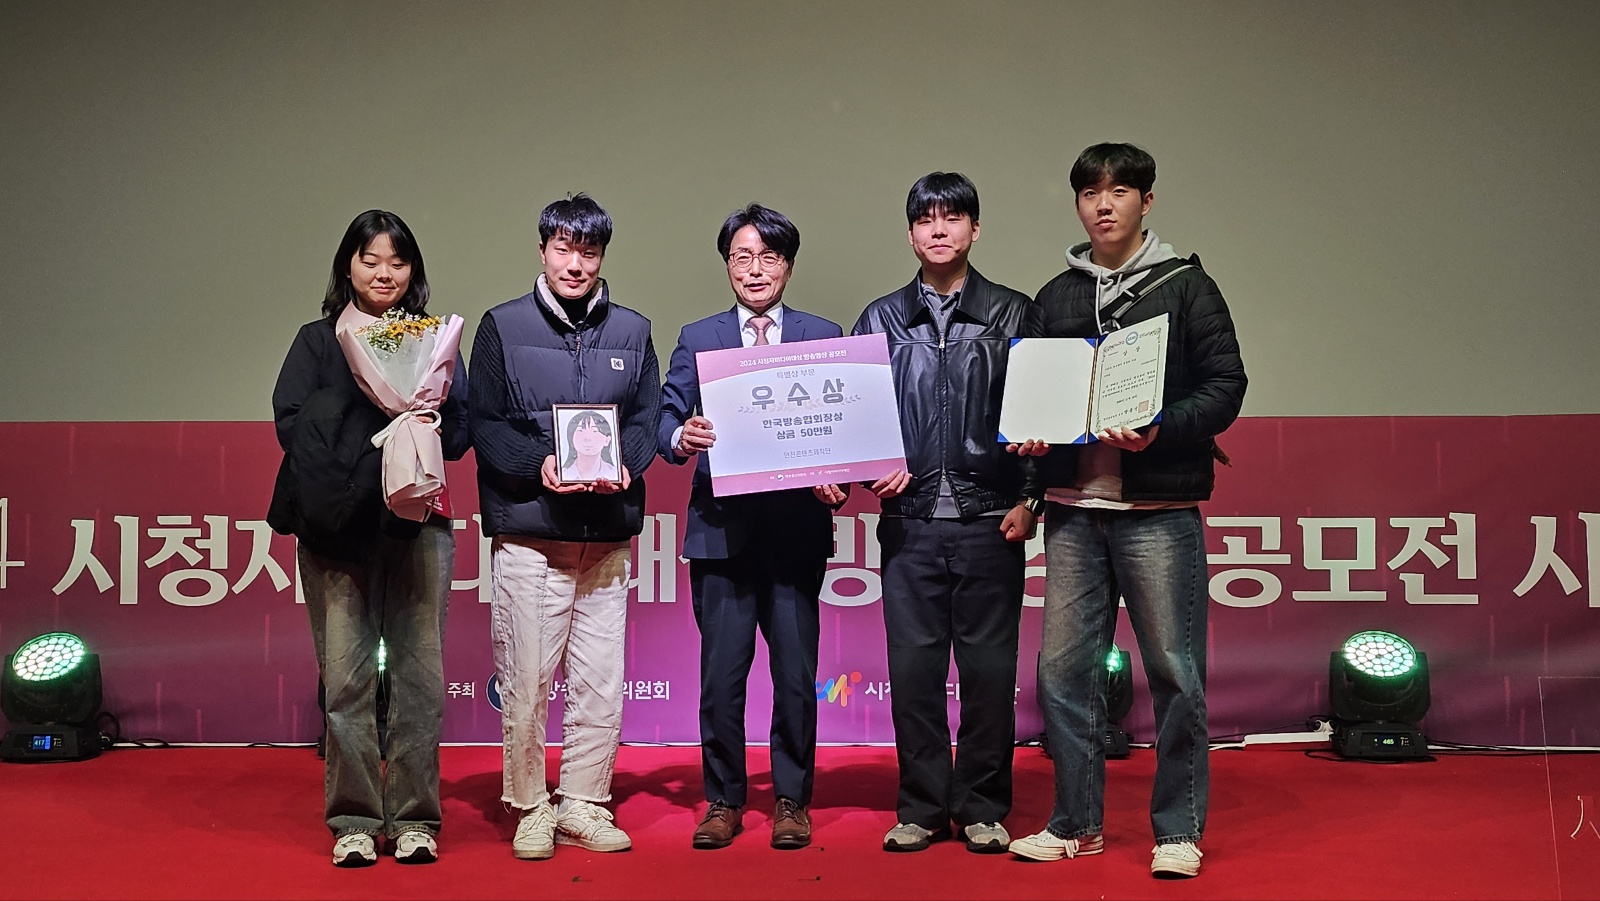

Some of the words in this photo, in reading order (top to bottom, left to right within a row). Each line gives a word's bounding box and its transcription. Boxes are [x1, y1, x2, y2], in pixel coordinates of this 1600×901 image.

[739, 359, 757, 367] 2024
[776, 370, 799, 379] 특별상
[800, 368, 816, 377] 부문
[762, 411, 843, 428] 한국방송협회장상
[776, 429, 796, 440] 상금
[800, 425, 833, 438] 50만원
[1206, 511, 1480, 608] 공모전
[447, 681, 476, 699] 주최
